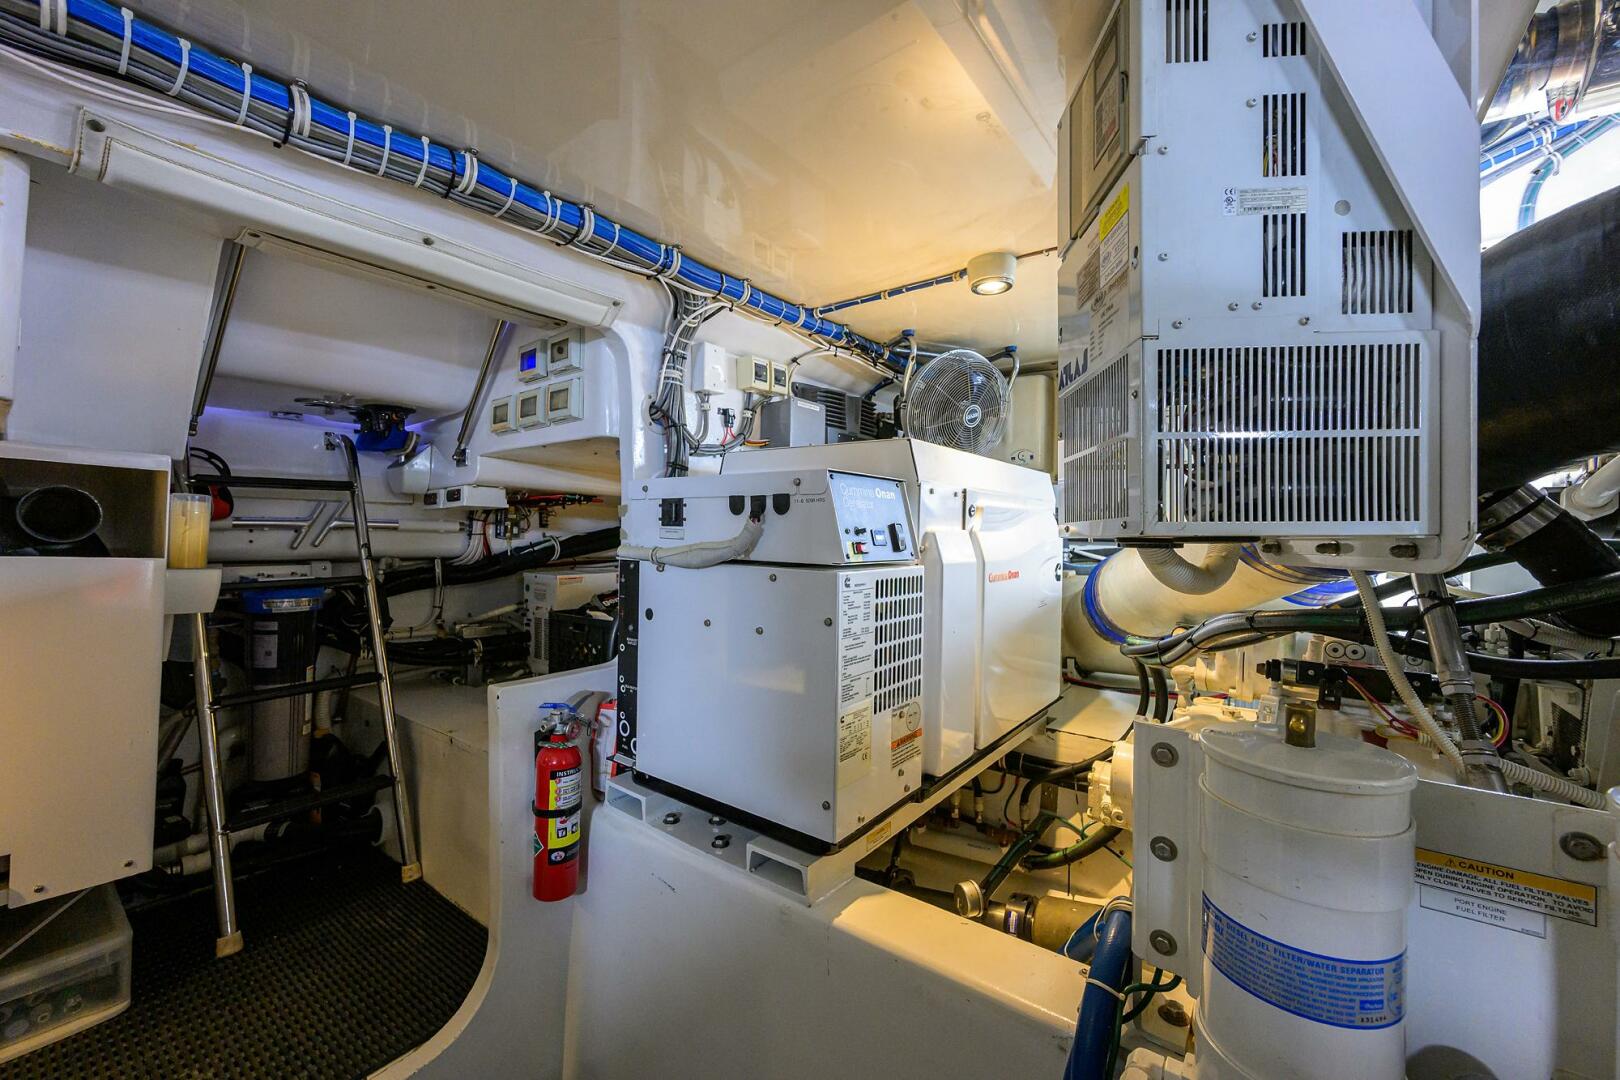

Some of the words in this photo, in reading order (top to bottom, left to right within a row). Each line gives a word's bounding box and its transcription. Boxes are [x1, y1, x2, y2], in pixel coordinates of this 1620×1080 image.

[875, 487, 896, 501] Onan
[1008, 570, 1020, 580] Onan
[1458, 861, 1514, 879] CAUTION
[1416, 862, 1445, 873] ENGINE
[1482, 877, 1499, 886] ALL
[1500, 881, 1522, 891] FUEL
[1523, 886, 1553, 898] FILTER
[1554, 893, 1589, 906] VALVES
[1433, 877, 1460, 888] CLOSE
[1461, 884, 1492, 896] VALVES
[1507, 895, 1544, 907] SERVICE
[1434, 872, 1464, 884] DURING
[1465, 879, 1496, 891] ENGINE
[1552, 899, 1565, 907] TO
[1567, 902, 1594, 914] AVOID
[1454, 897, 1476, 907] PORT
[1477, 903, 1507, 915] ENGINE
[1455, 905, 1477, 915] FUEL
[1477, 911, 1506, 922] FILTER
[1251, 937, 1270, 952] FUEL
[1340, 966, 1385, 976] SEPARATOR
